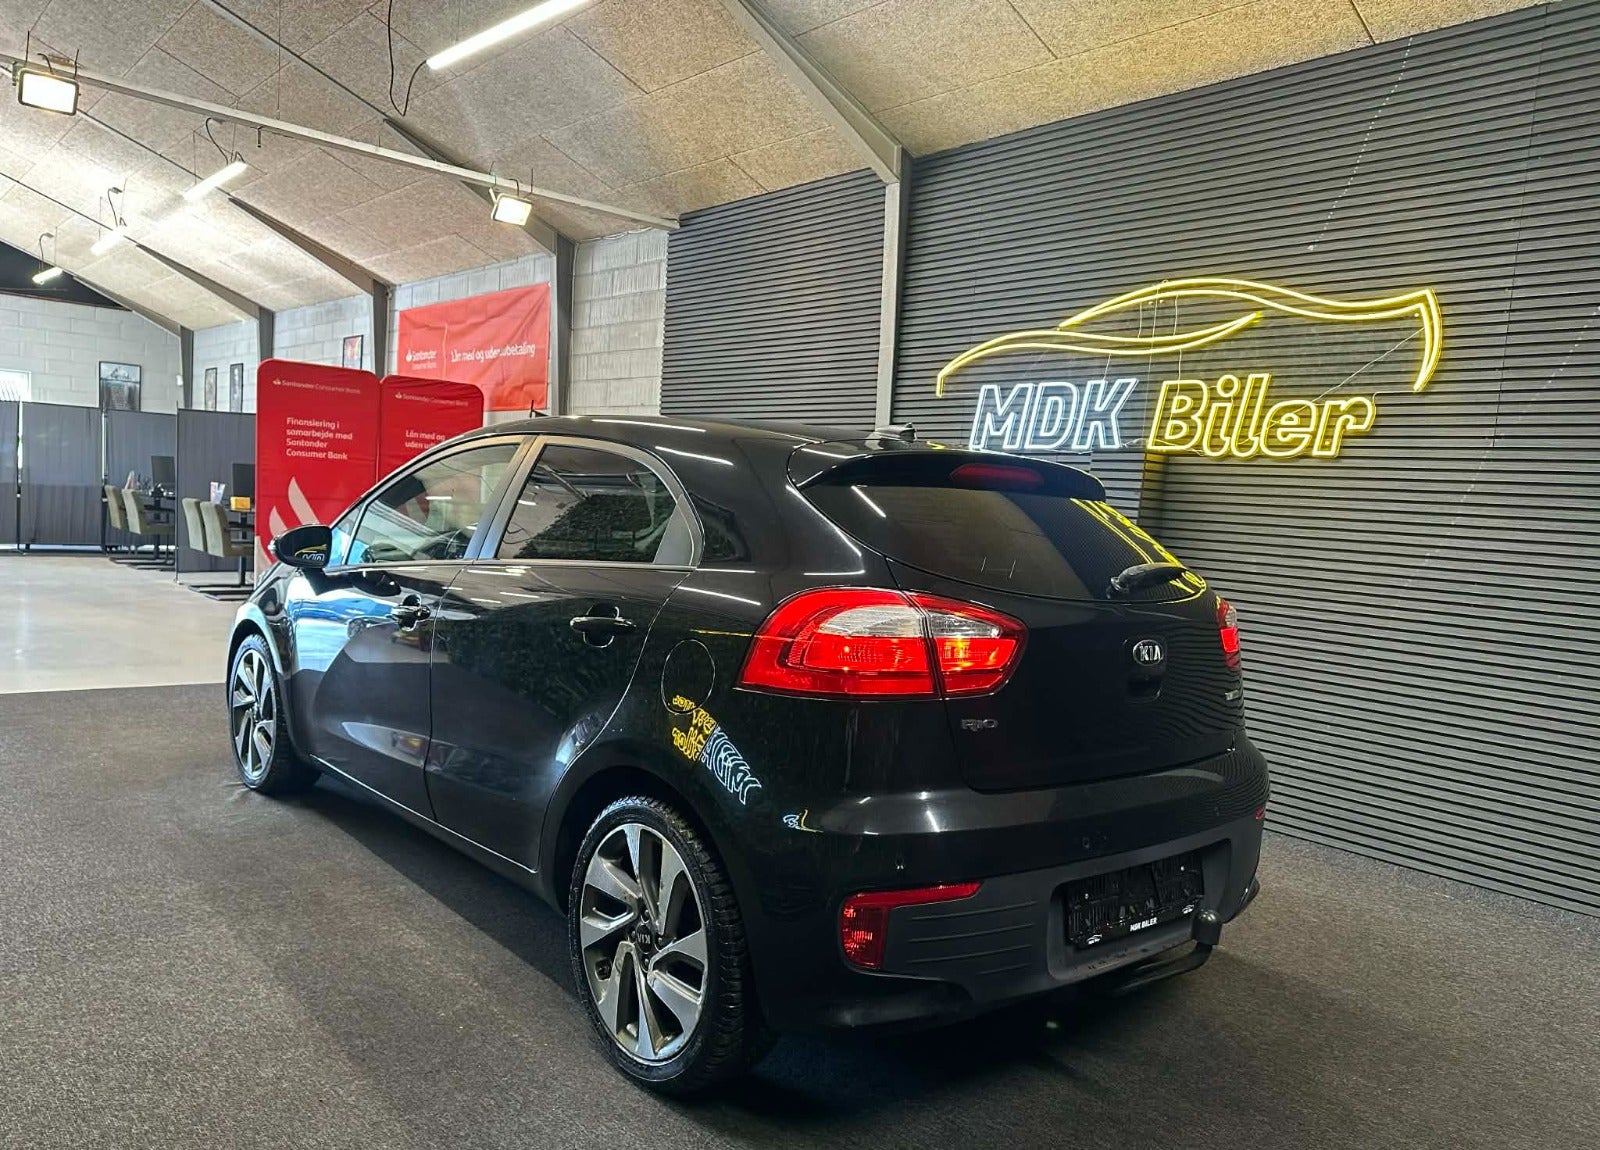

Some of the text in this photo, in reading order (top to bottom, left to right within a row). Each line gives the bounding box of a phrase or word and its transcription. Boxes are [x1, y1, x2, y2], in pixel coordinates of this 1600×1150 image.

[477, 349, 485, 363] og
[282, 380, 314, 388] Santander
[969, 373, 1378, 458] MDK Biler
[286, 417, 336, 430] Finansiering
[286, 428, 353, 440] samarbejde med
[405, 429, 419, 438] Lån
[420, 432, 435, 440] med
[286, 438, 327, 448] Santander
[405, 441, 423, 449] uden
[286, 449, 348, 460] Consumer Bank
[1139, 644, 1161, 661] KIA
